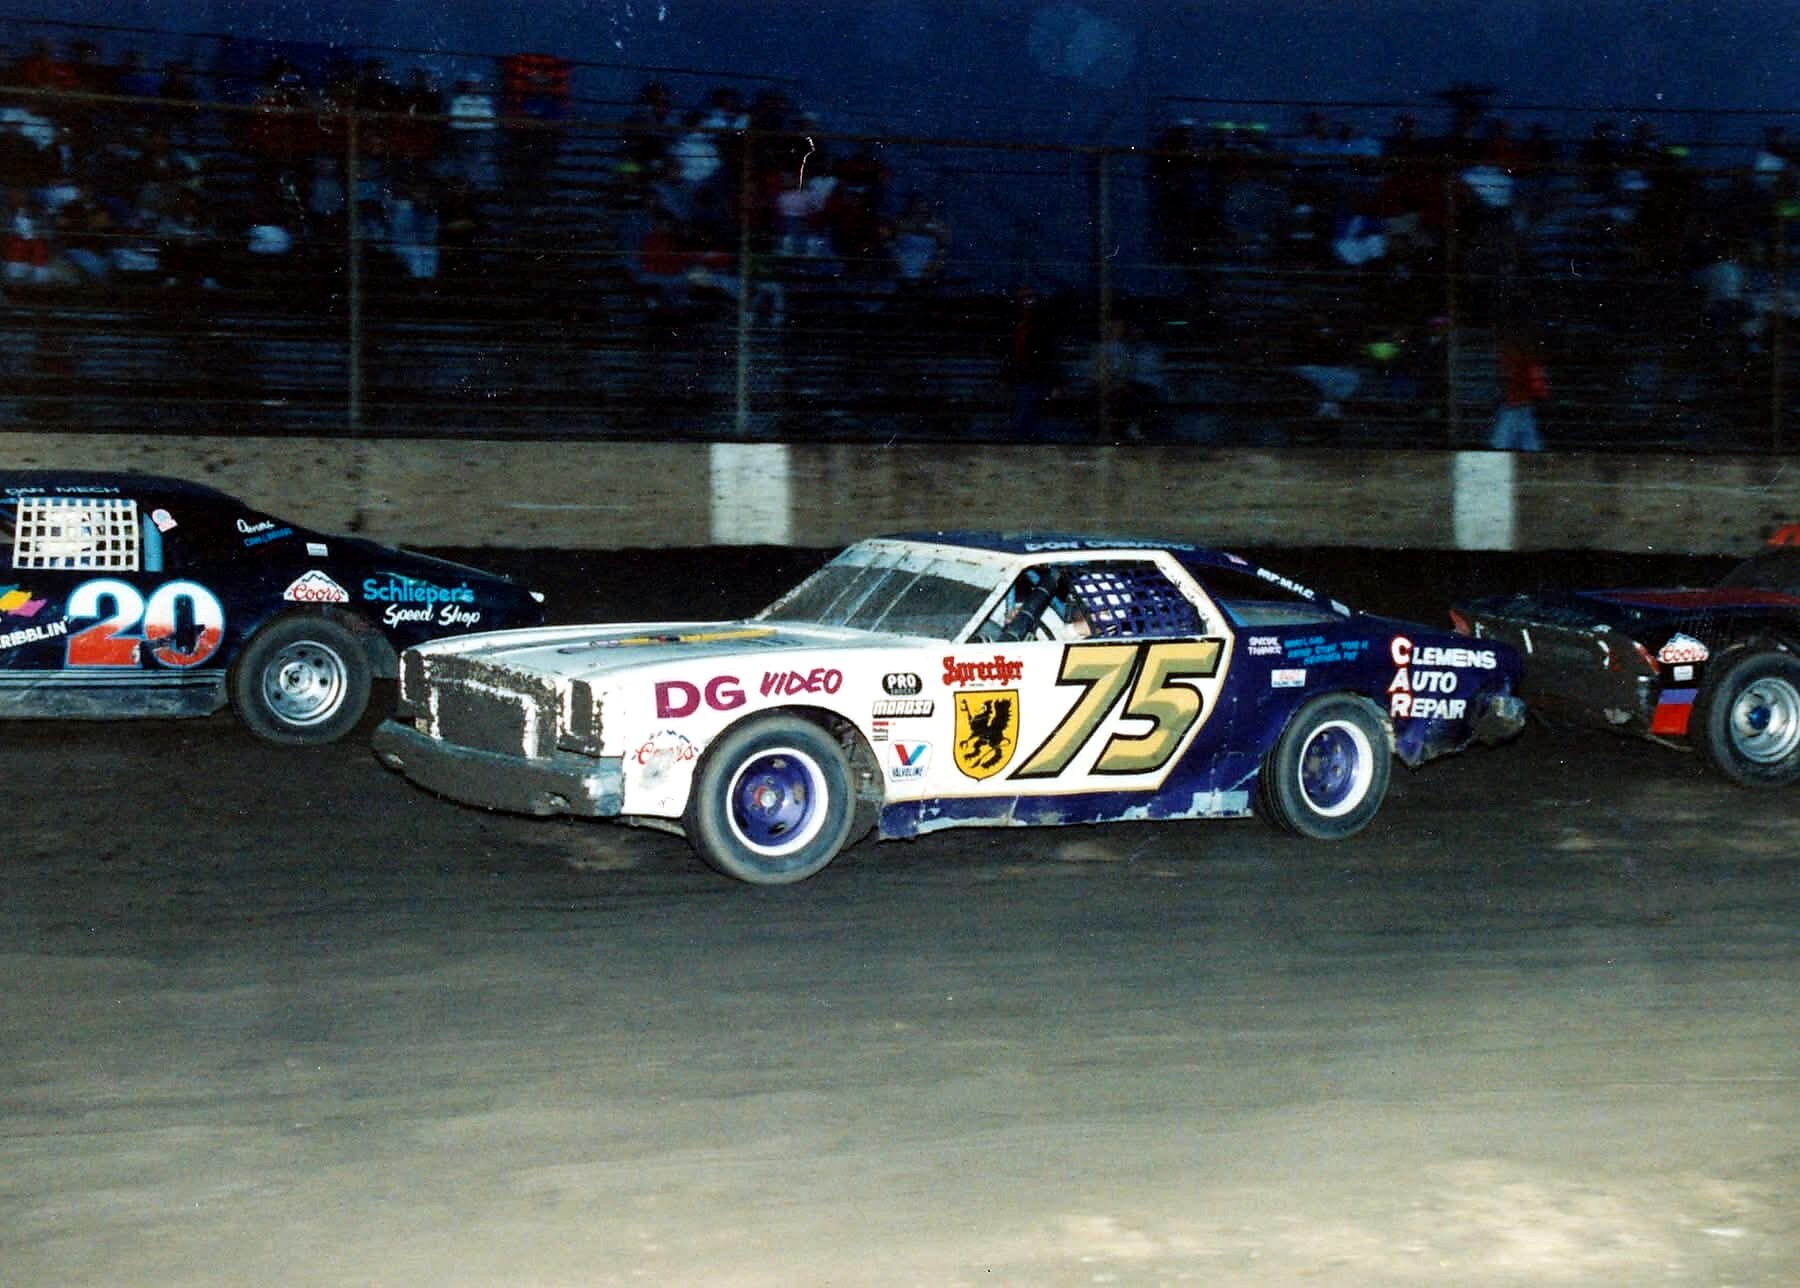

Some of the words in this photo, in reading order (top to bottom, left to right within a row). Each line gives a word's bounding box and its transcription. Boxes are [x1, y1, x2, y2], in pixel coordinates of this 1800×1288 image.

[293, 583, 342, 601] Coors
[363, 577, 475, 609] Schlieper's
[65, 578, 225, 669] 20
[383, 604, 433, 628] Speed
[438, 604, 481, 628] Shop
[1391, 635, 1497, 669] CLEMENS
[887, 674, 917, 689] PRO
[942, 655, 1023, 687] Sprecher
[1388, 668, 1457, 693] AUTO
[654, 674, 747, 719] DG
[759, 667, 843, 697] VIDEO
[1006, 638, 1226, 780] 75
[1390, 693, 1467, 719] REPAIR
